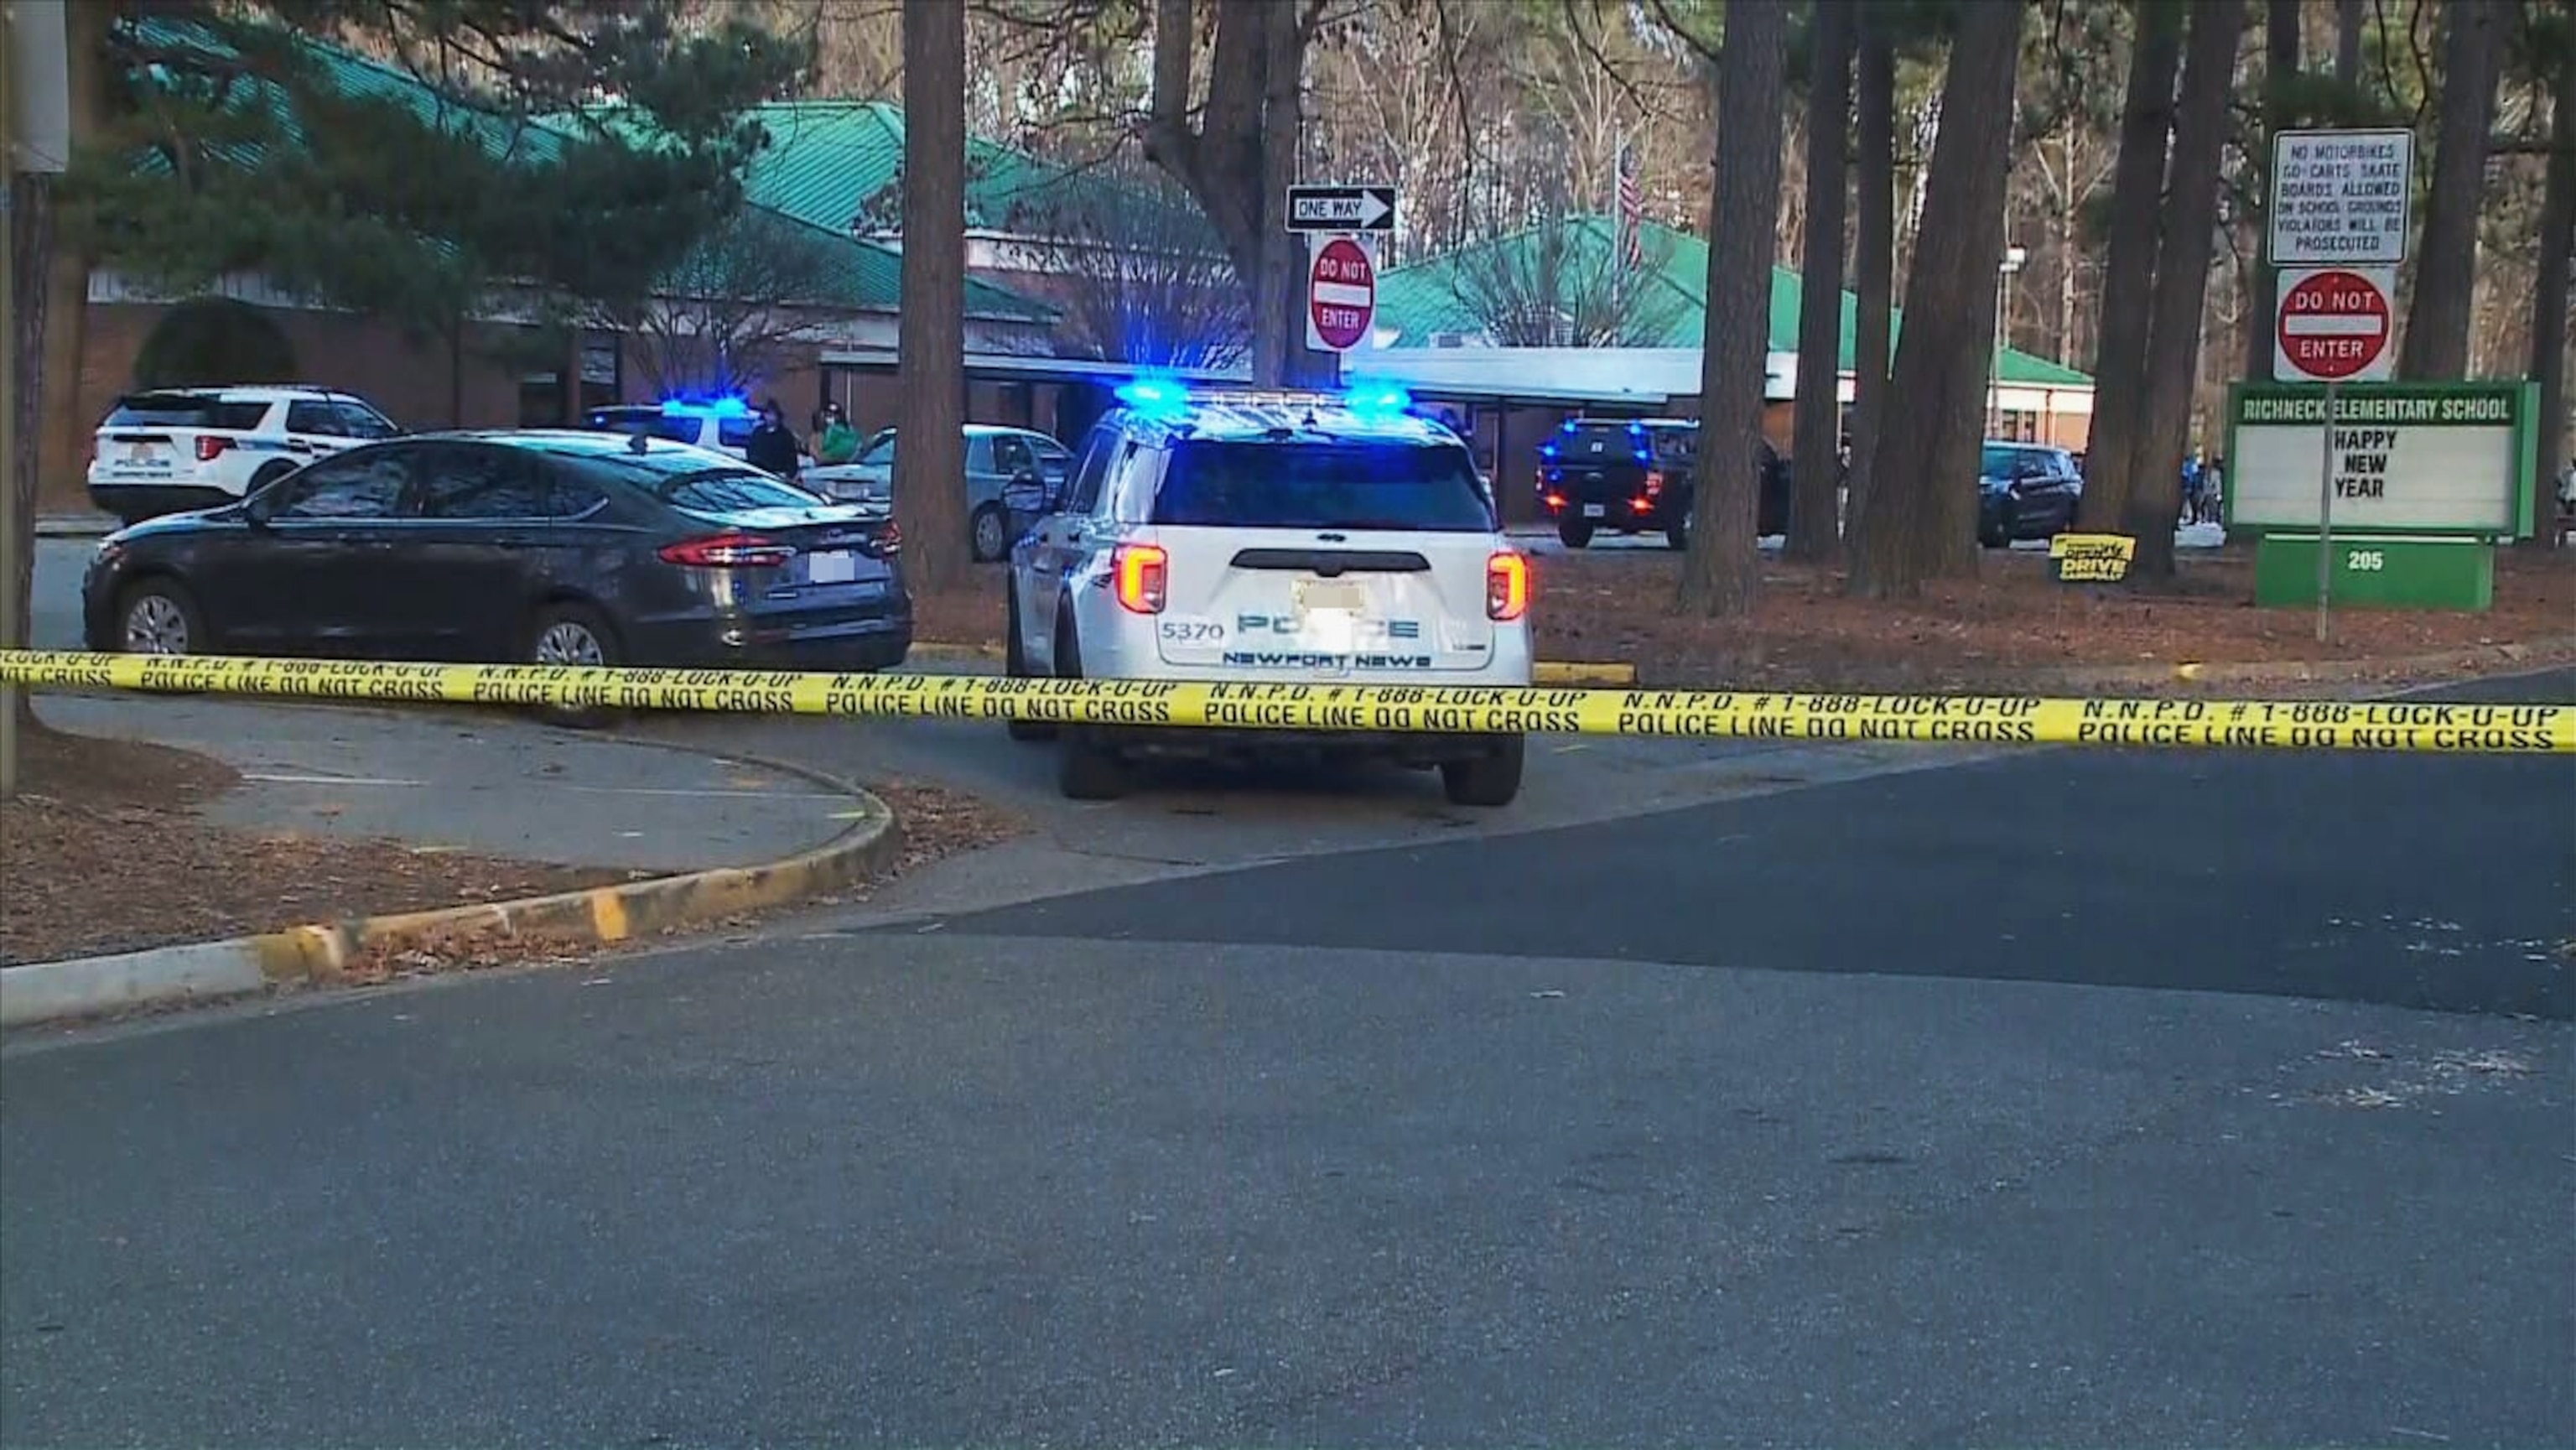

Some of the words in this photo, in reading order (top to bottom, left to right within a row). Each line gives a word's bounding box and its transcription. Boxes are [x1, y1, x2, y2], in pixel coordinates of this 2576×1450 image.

[2291, 144, 2308, 159] NO
[2315, 144, 2394, 159] MOTORBIKES
[2360, 163, 2401, 178] SKATE
[2282, 183, 2333, 197] BOARDS
[2342, 182, 2400, 196] ALLOWED
[1300, 200, 1327, 216] ONE
[1333, 201, 1363, 216] WAY
[2278, 201, 2293, 214] ON
[2298, 200, 2340, 214] SCHOOL
[2348, 200, 2402, 214] GROUNDS
[2278, 218, 2340, 232] VIOLATORS
[2349, 218, 2375, 232] WILL
[2385, 217, 2402, 232] BE
[2295, 236, 2380, 252] PROSECUTED
[1320, 258, 1337, 278] DO
[1343, 261, 1367, 280] NOT
[2295, 291, 2322, 309] DO
[2332, 290, 2375, 309] NOT
[1322, 308, 1360, 329] ENTER
[2300, 340, 2365, 359] ENTER
[2243, 400, 2326, 420] RICHNECK
[2333, 399, 2436, 420] ELEMENTARY
[2442, 398, 2509, 419] SCHOOL
[2334, 429, 2397, 450] HAPPY
[2345, 455, 2386, 474] NEW
[2334, 479, 2384, 498] YEAR
[2062, 559, 2127, 574] DRIVE
[2349, 552, 2383, 570] 205
[1161, 622, 1225, 640] 5370
[1223, 652, 1350, 668] NEWPORT
[1356, 654, 1431, 668] NEWS
[0, 667, 32, 683] OT
[40, 667, 112, 686] CROSS
[141, 671, 216, 690] POLICE
[224, 673, 270, 692] LINE
[280, 676, 308, 694] DO
[319, 678, 361, 696] NOT
[369, 678, 443, 699] CROSS
[832, 676, 927, 691] N.N.P.D.
[964, 678, 1176, 698] 1-888-LOCK-U-UP
[1211, 683, 1316, 701] N.N.P.D.
[1355, 688, 1587, 707] 1-888-LOCK-U-UP
[473, 682, 552, 702] POLICE
[562, 683, 612, 704] LINE
[621, 686, 648, 707] DO
[661, 688, 707, 709] NOT
[715, 689, 793, 712] CROSS
[1623, 692, 1741, 711] N.N.P.D.
[1784, 696, 2040, 717] 1-888-LOCK-U-UP
[827, 692, 911, 715] POLICE
[920, 695, 974, 716] LINE
[984, 697, 1015, 718] DO
[1027, 698, 1076, 720] NOT
[1086, 699, 1170, 722] CROSS
[2085, 701, 2215, 722] N.N.P.D.
[2264, 704, 2558, 727] 1-888-LOCK-U-UP
[1205, 703, 1296, 725] POLICE
[1308, 706, 1364, 727] LINE
[1375, 707, 1410, 729] DO
[1425, 709, 1478, 730] NOT
[1487, 709, 1580, 732] CROSS
[1618, 713, 1719, 734] POLICE
[1731, 715, 1794, 736] LINE
[1808, 717, 1846, 738] DO
[1861, 719, 1919, 740] NOT
[1931, 720, 2034, 741] CROSS
[2079, 722, 2192, 743] POLICE
[2205, 725, 2277, 745] LINE
[2291, 727, 2334, 746] DO
[2352, 727, 2417, 748] NOT
[2434, 729, 2556, 750] CROSS
